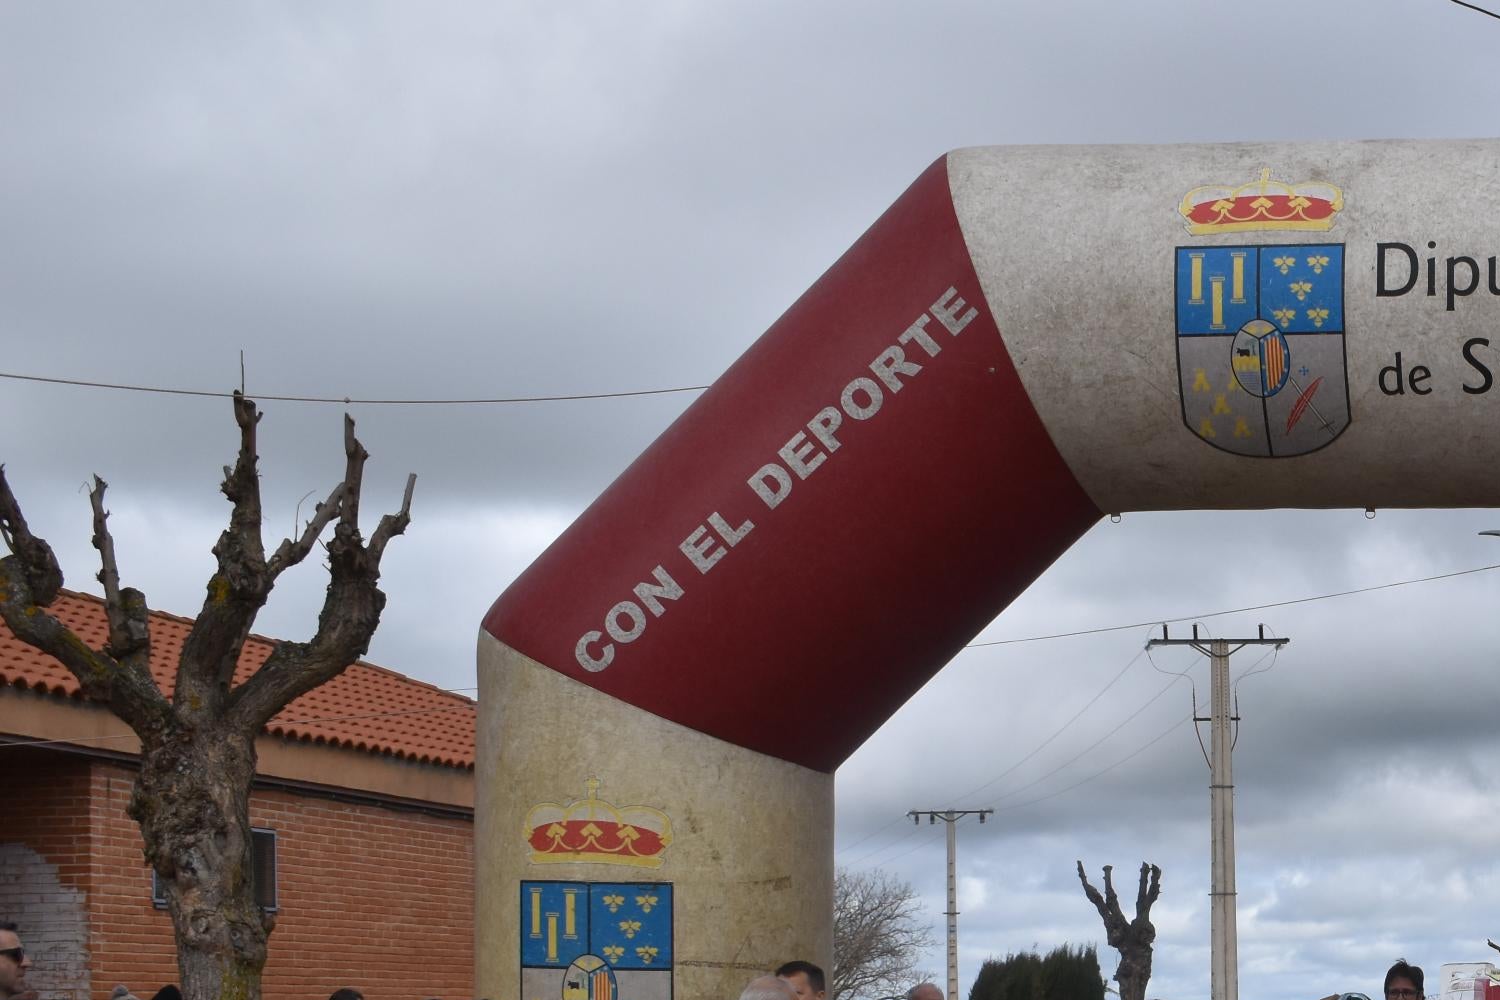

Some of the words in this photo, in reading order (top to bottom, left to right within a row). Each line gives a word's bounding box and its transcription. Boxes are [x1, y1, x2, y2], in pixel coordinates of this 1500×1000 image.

[575, 565, 685, 673] CON
[678, 511, 756, 575] EL
[747, 286, 979, 510] DEPORTE
[1378, 352, 1433, 396] de
